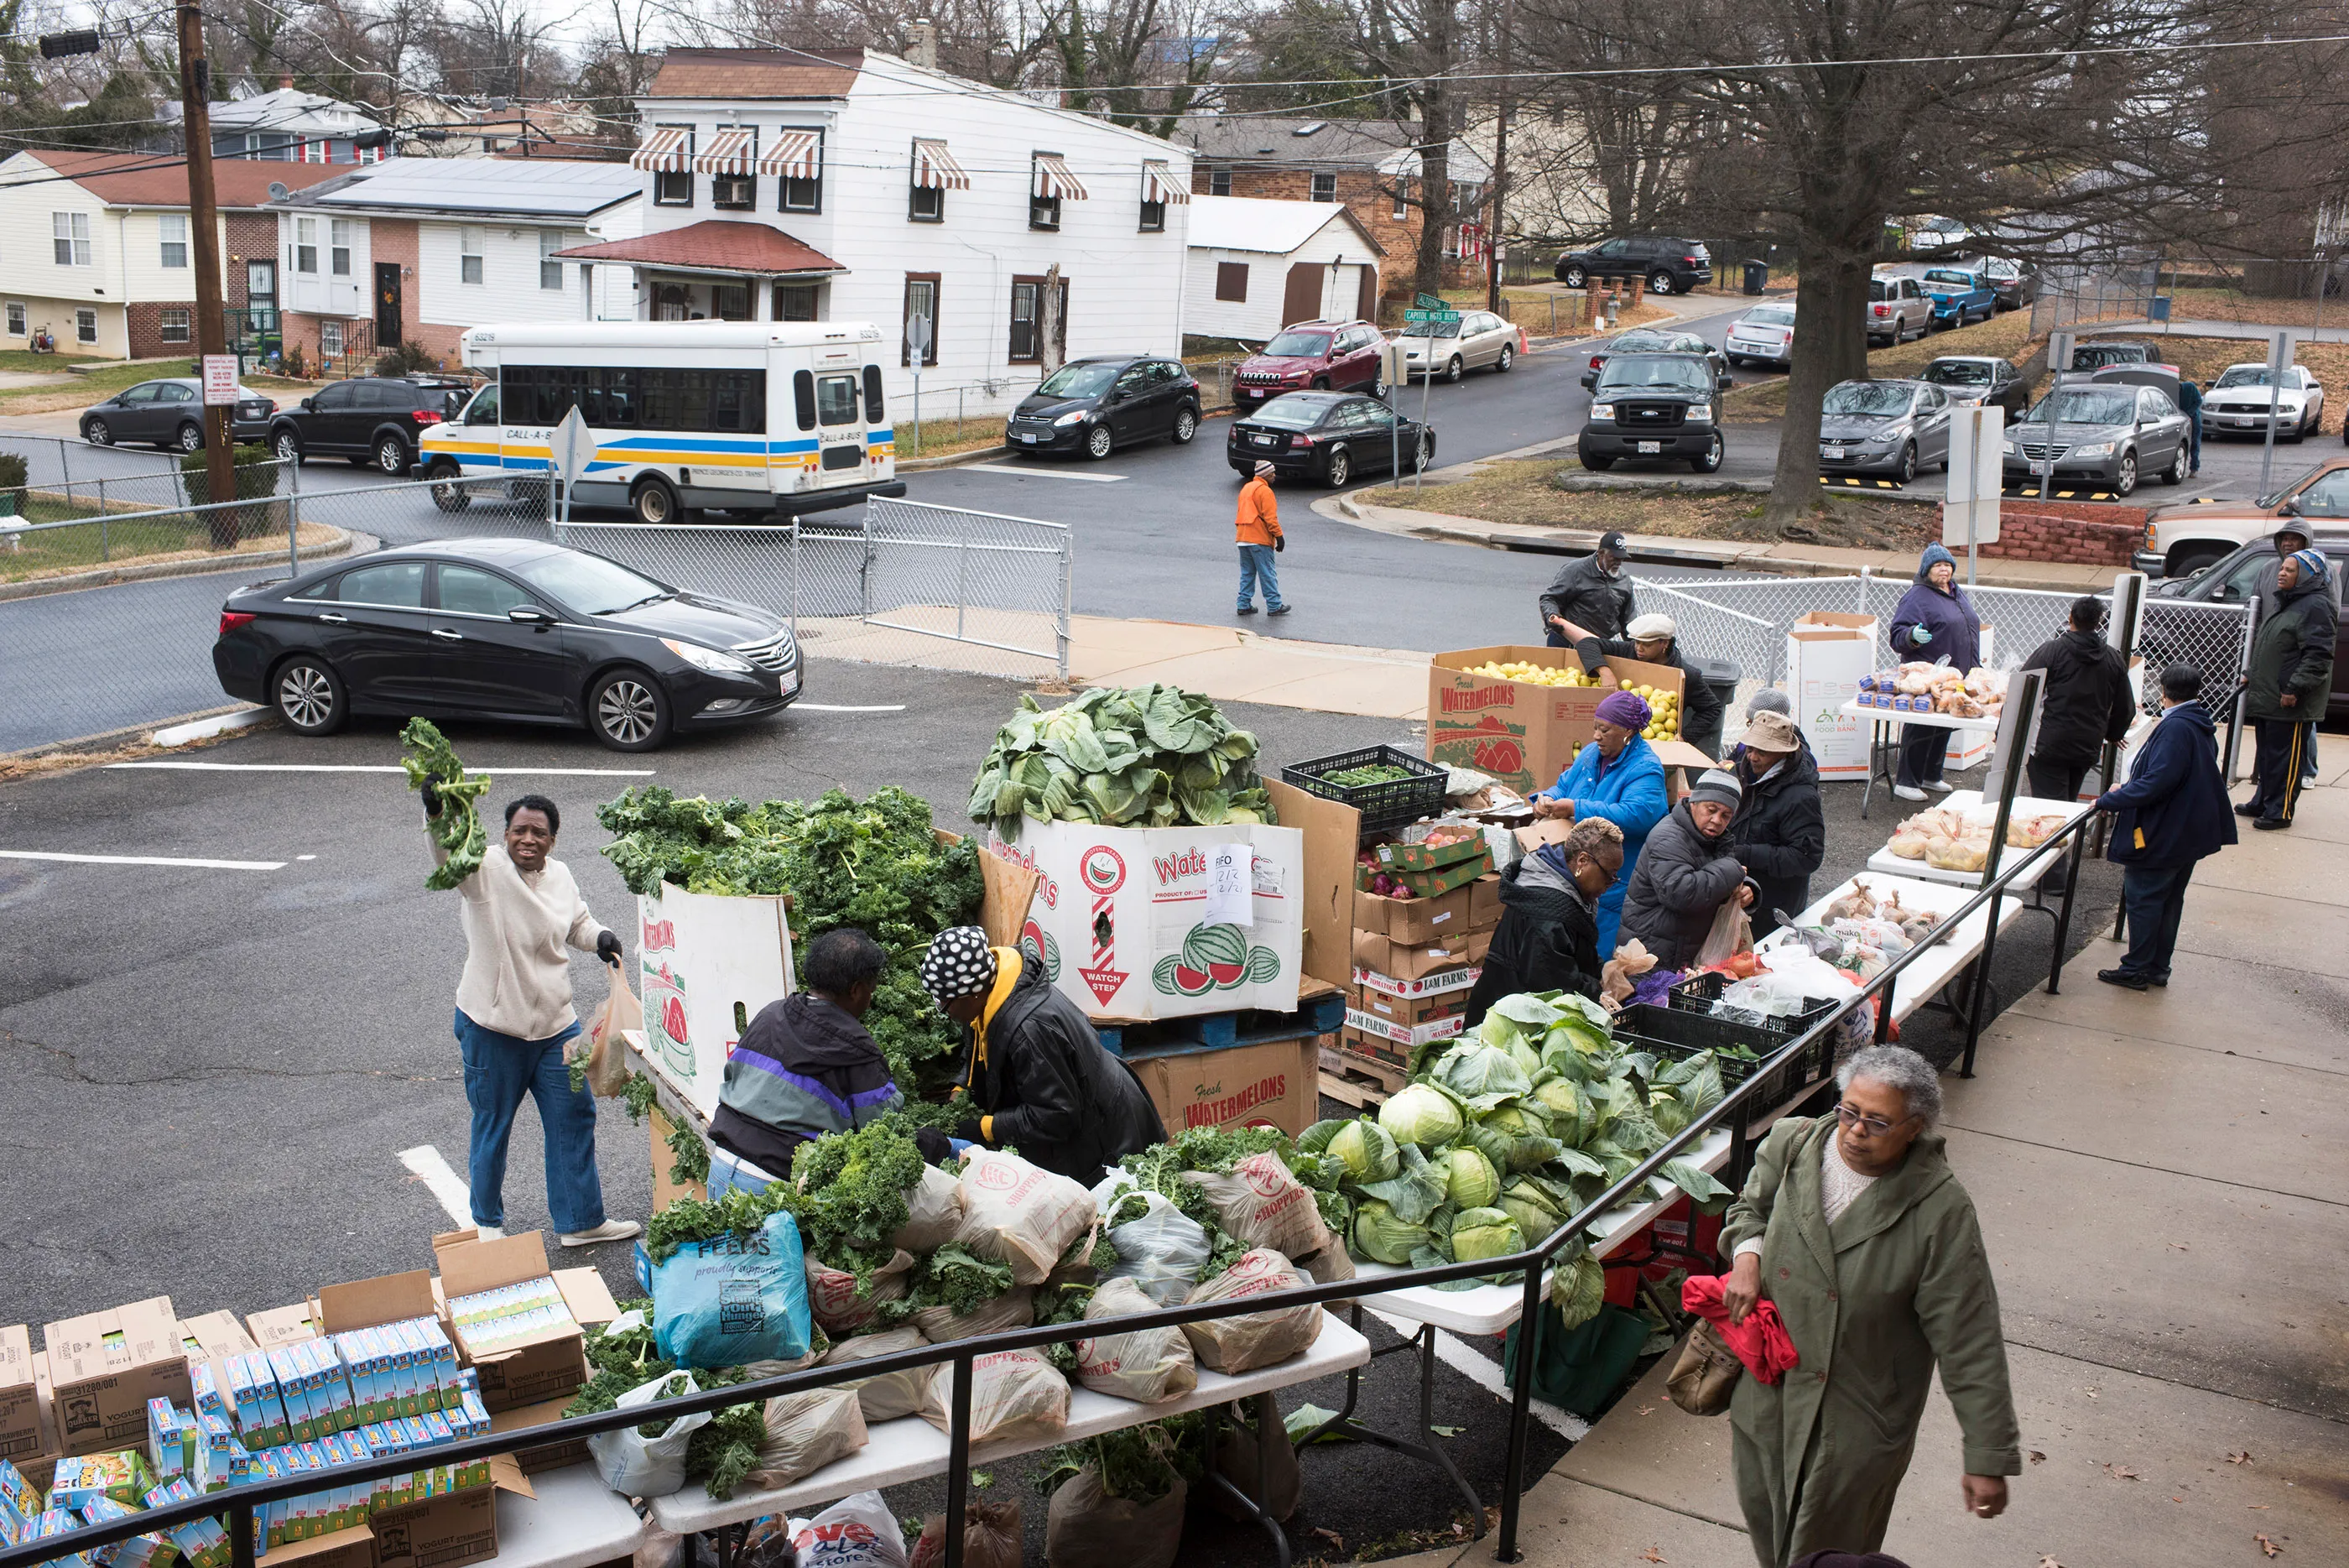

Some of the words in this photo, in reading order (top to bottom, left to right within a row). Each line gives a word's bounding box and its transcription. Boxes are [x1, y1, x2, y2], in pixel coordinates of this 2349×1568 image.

[1419, 295, 1440, 308] ALTOONA
[1406, 311, 1427, 320] CAPITOL
[1445, 312, 1457, 320] BLVD
[475, 333, 495, 341] 63219
[860, 330, 879, 339] 63219
[507, 430, 552, 440] CALL-A-B
[820, 431, 861, 443] CALL-A-BUS
[1455, 675, 1474, 690] Fresh
[1441, 685, 1514, 713] WATERMELONS
[1083, 847, 1107, 862] LYCOPENE
[1107, 847, 1122, 865] LEADER
[1216, 855, 1232, 867] FIFO
[1086, 881, 1102, 893] FRESH
[1103, 878, 1123, 893] PRODUCE
[643, 915, 675, 951] WATERMELONS
[1836, 929, 1859, 938] make
[1086, 972, 1121, 983] WATCH
[1369, 977, 1397, 992] TOMATOES
[1424, 977, 1440, 991] L&M
[1442, 971, 1468, 987] FARMS
[1092, 983, 1116, 992] STEP
[1348, 1012, 1363, 1026] L&M
[1365, 1018, 1389, 1035] FARMS
[1389, 1031, 1411, 1043] TOMATOES
[1195, 1081, 1221, 1101] Fresh
[1185, 1074, 1285, 1131] WATERMELONS
[1006, 1168, 1045, 1208] SHOPPERS
[1255, 1186, 1305, 1223] SHOPPERS
[698, 1237, 771, 1258] FEEDS
[695, 1262, 736, 1280] proudly
[738, 1263, 779, 1275] supports
[61, 1341, 72, 1360] YOGURT
[972, 1352, 1039, 1373] HOPPERS
[511, 1370, 545, 1383] YOGURT
[547, 1364, 581, 1378] STRAWBERRY
[76, 1378, 118, 1395] 31280/001
[68, 1415, 99, 1428] QUAKER
[107, 1407, 147, 1421] YOGURT
[0, 1427, 36, 1440] TRAWBERRY
[78, 1465, 100, 1489] CHEWY
[390, 1506, 430, 1524] 31280/001
[417, 1535, 456, 1551] YOGURT
[456, 1529, 493, 1544] STRAWBERRY
[793, 1524, 877, 1555] ave
[382, 1544, 410, 1555] QUAKER
